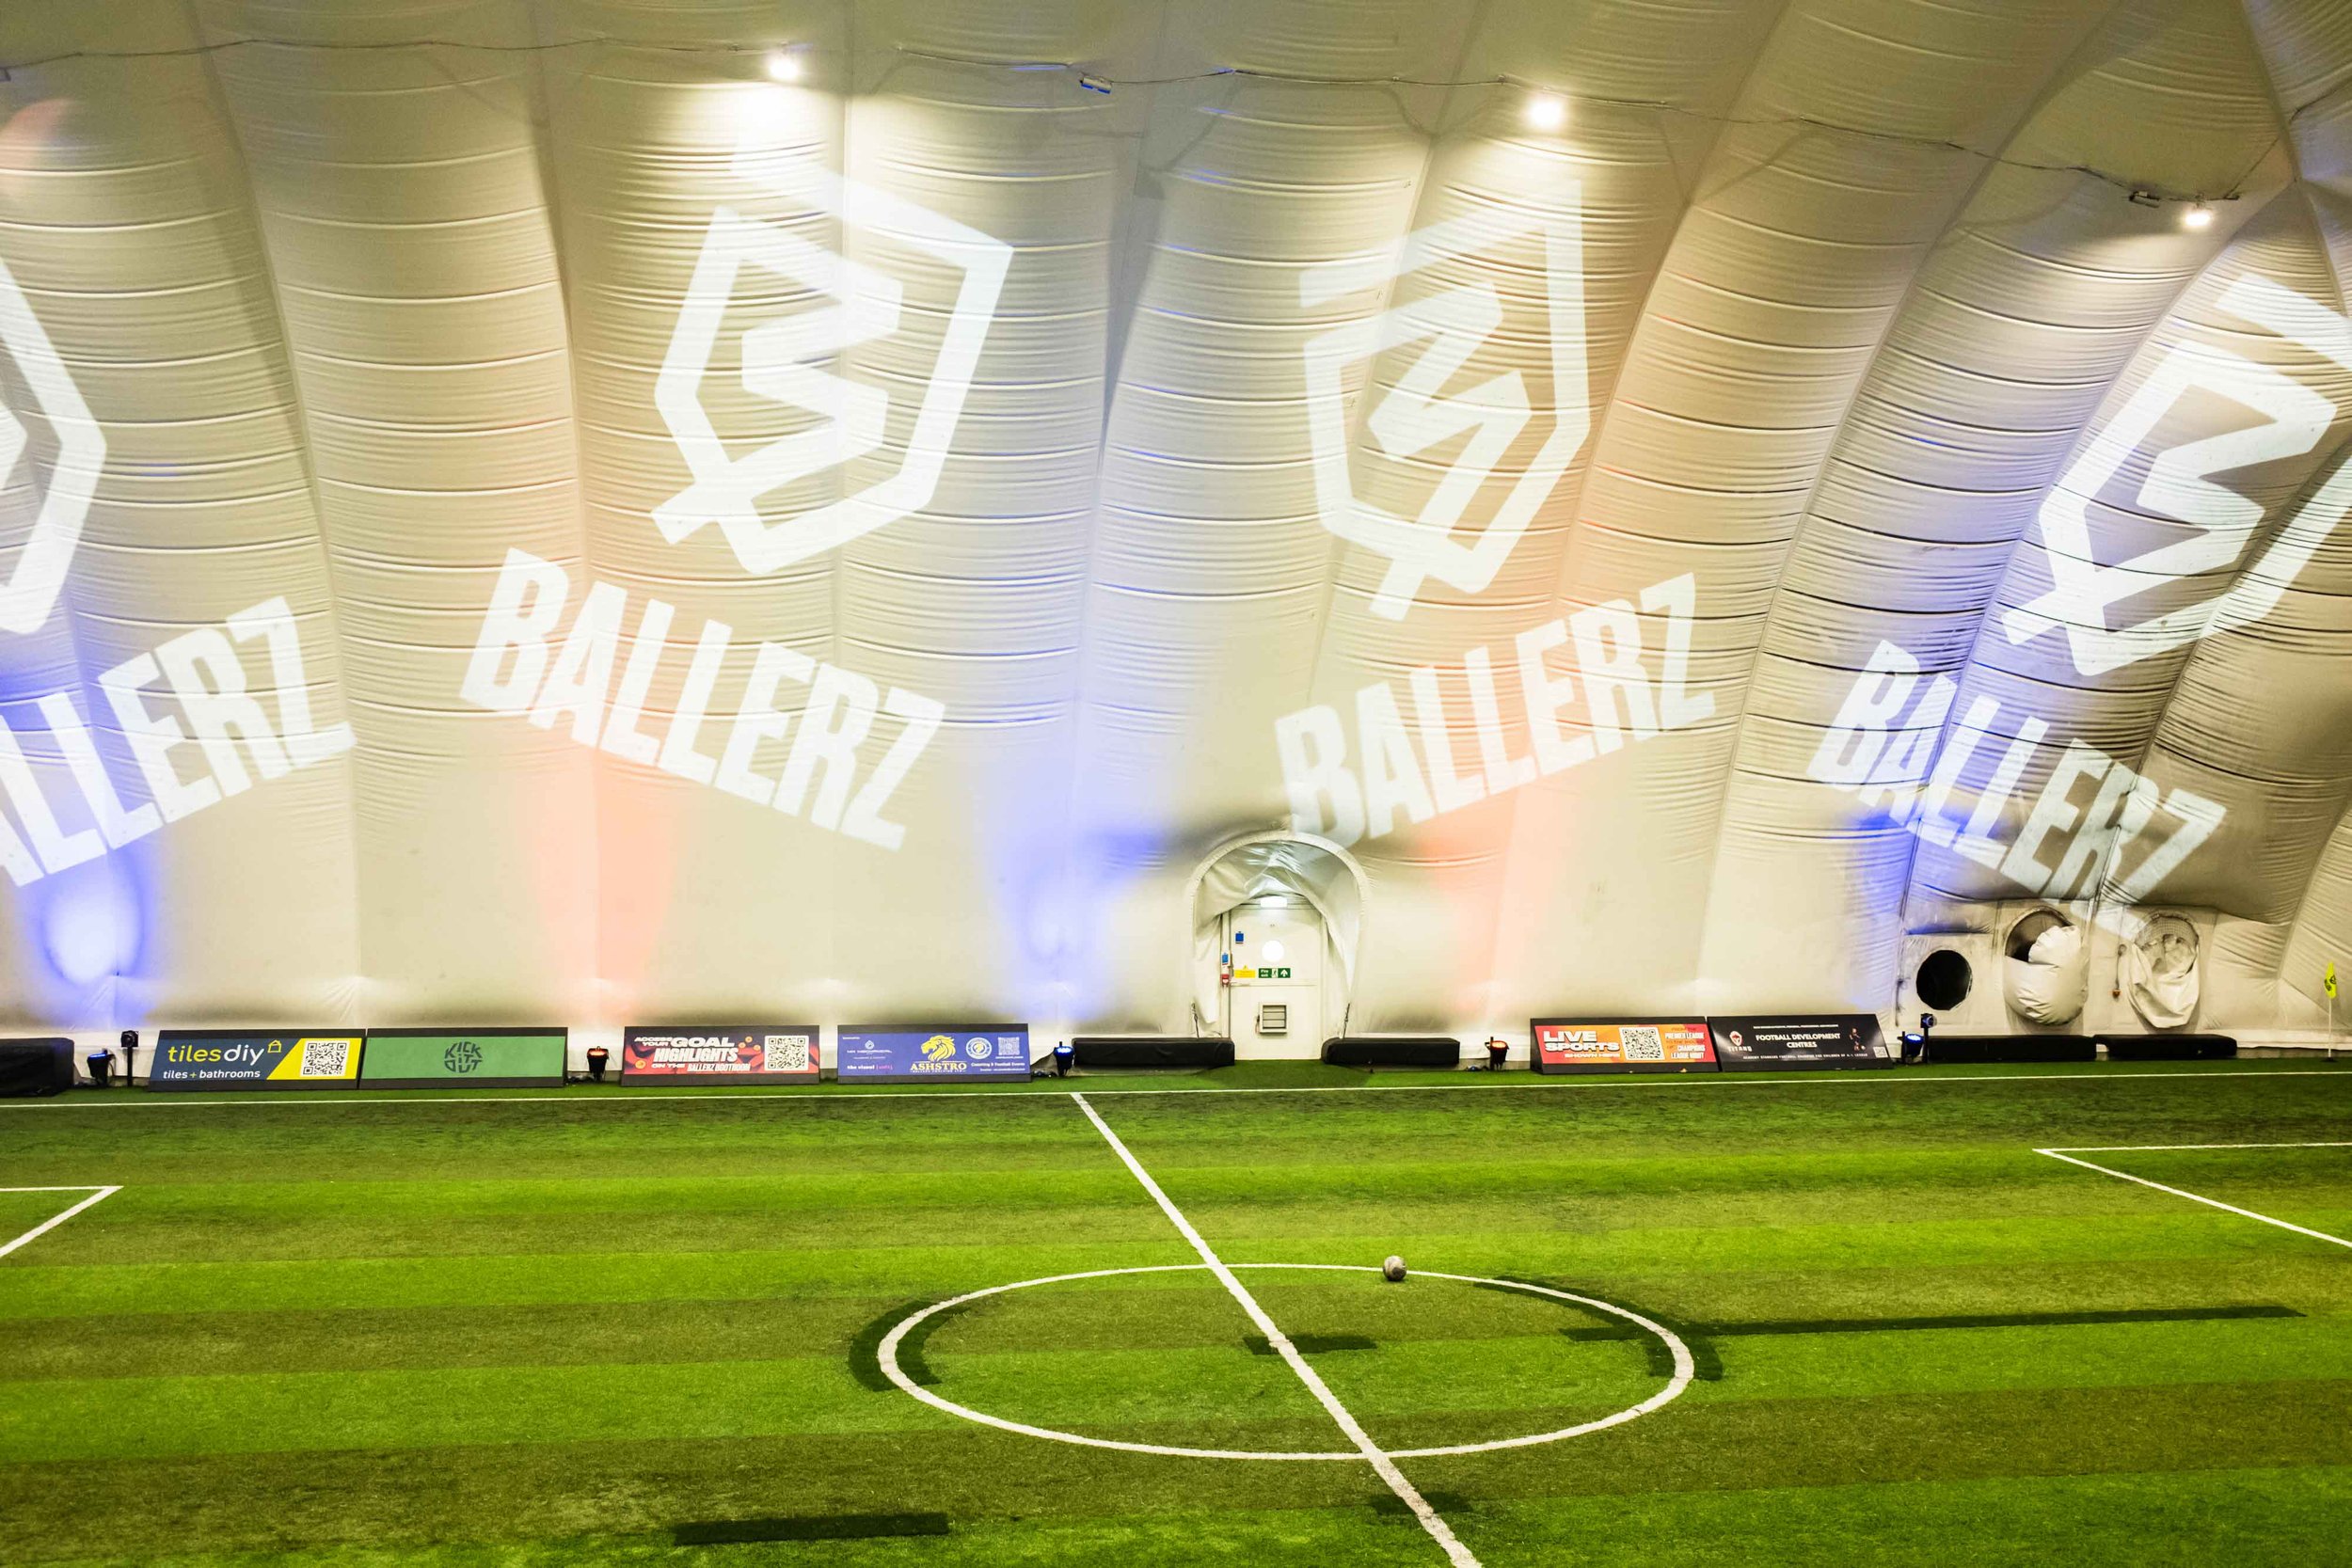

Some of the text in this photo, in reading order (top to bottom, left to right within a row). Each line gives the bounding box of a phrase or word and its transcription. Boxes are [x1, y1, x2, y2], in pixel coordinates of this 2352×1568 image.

[460, 547, 945, 851] BALLERZ
[1274, 572, 1715, 847] BALLERZ
[1805, 640, 2226, 939] BALLERZ
[670, 1037, 735, 1048] GOAL
[1543, 1031, 1597, 1043] LIVE
[444, 1041, 483, 1059] KICK
[1545, 1042, 1620, 1052] SPORTS
[653, 1047, 739, 1063] HIGHLIGHTS
[444, 1059, 483, 1073] OUT
[687, 1063, 715, 1071] BALLERZ
[910, 1062, 967, 1071] ASHSTRO
[163, 1070, 188, 1079] tiles
[199, 1069, 261, 1079] bathrooms
